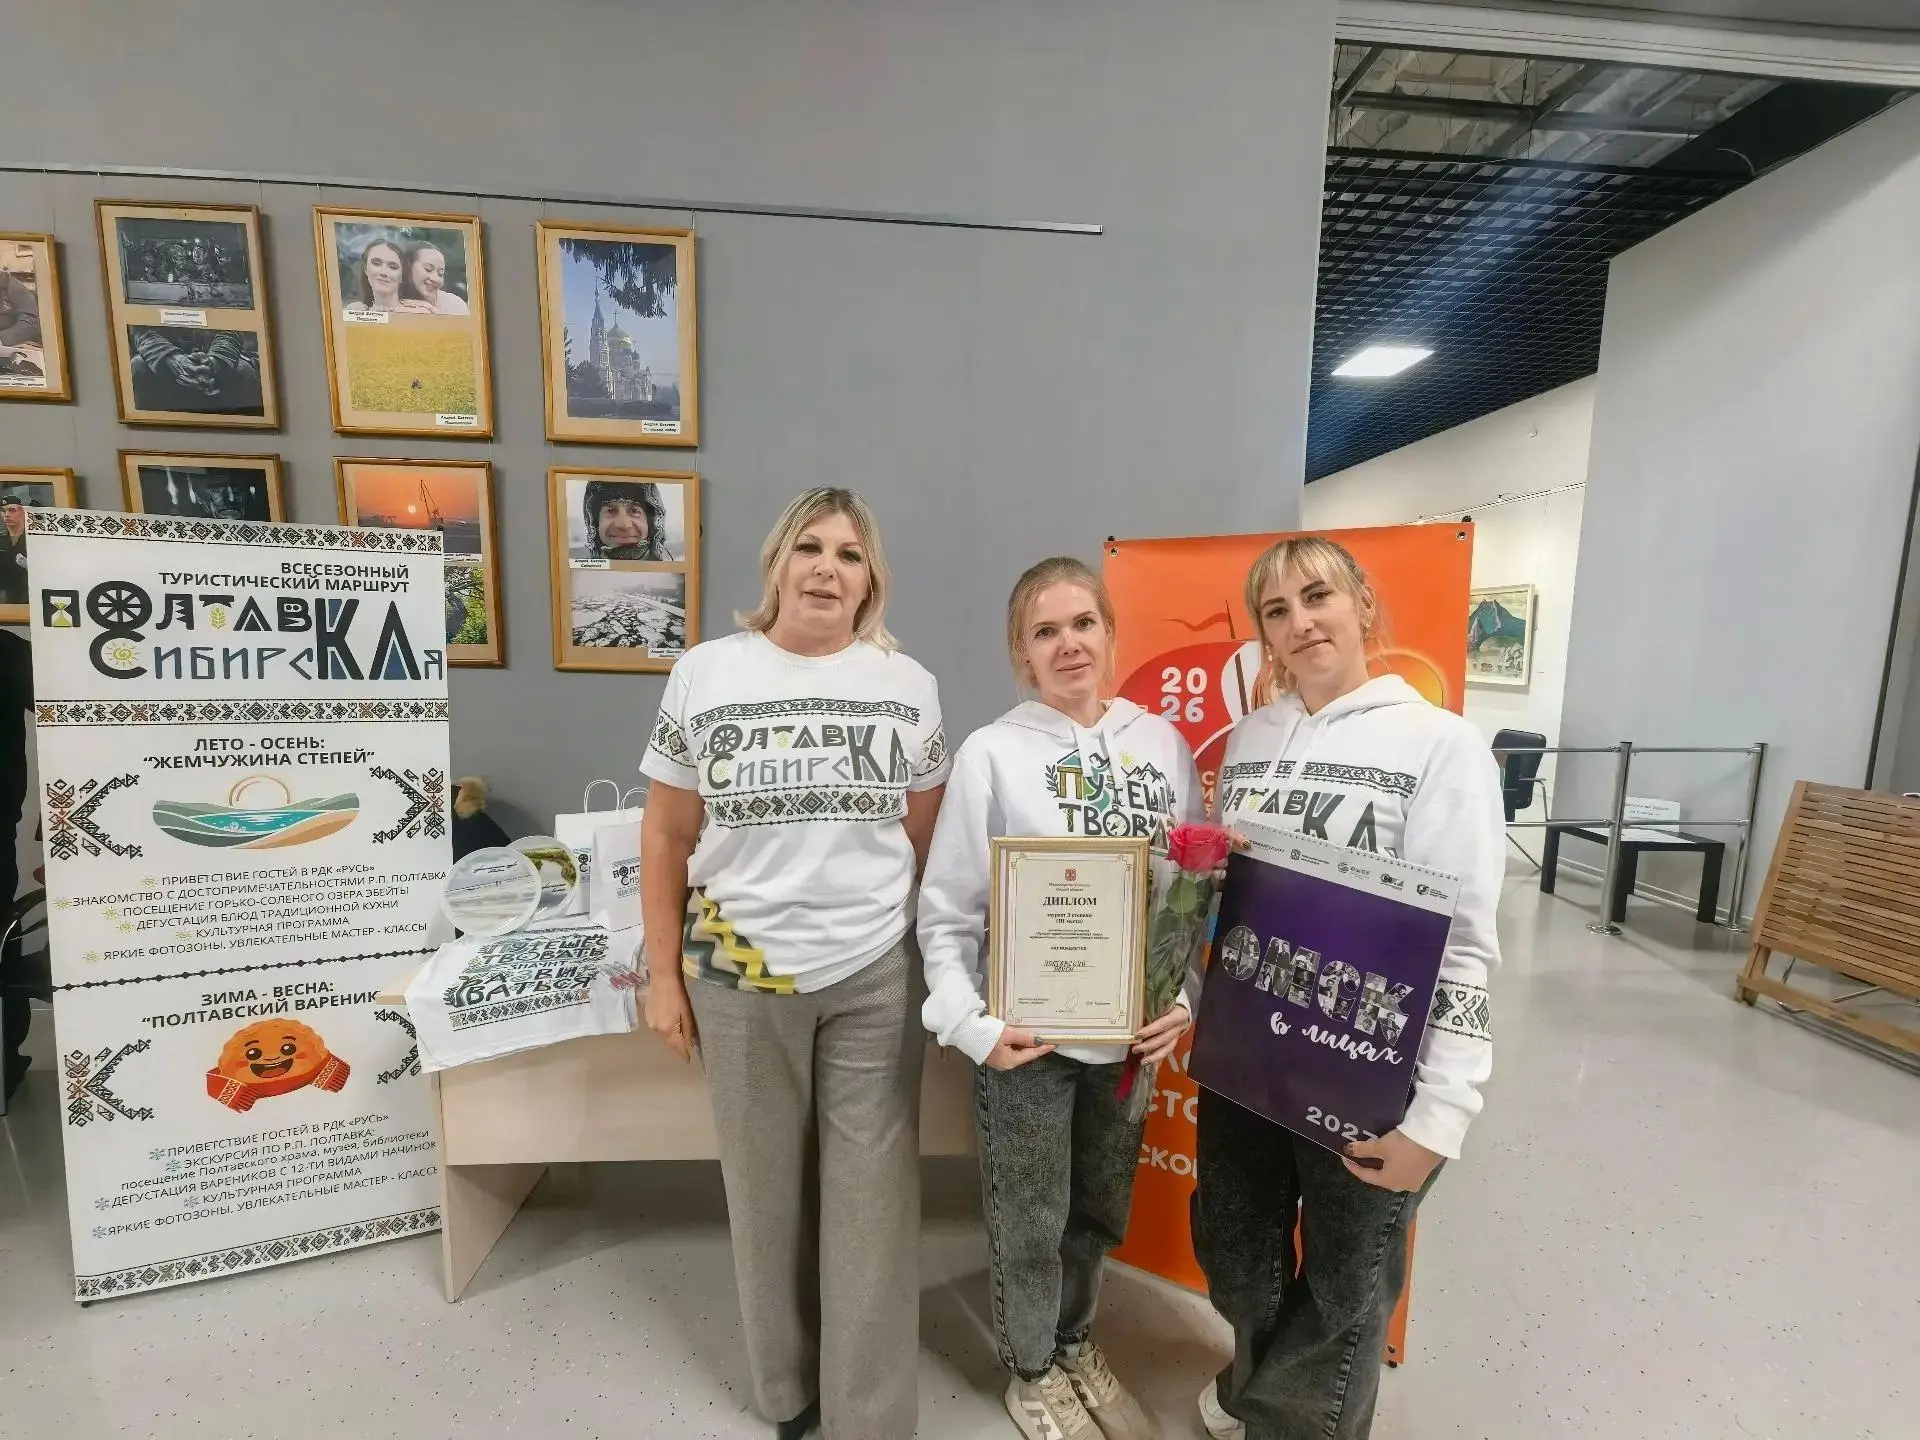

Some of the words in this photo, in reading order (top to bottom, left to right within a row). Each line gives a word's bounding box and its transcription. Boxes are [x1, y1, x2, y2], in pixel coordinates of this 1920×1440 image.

[158, 572, 320, 590] ТУРИСТИЧЕСКИЙ
[325, 579, 410, 593] МАРШРУТ
[281, 562, 410, 579] ВСЕСЕЗОННЫЙ
[1161, 666, 1207, 694] 20
[1161, 695, 1204, 723] 26
[193, 738, 244, 752] ЛЕТО
[260, 736, 326, 750] ОСЕНЬ:
[72, 891, 163, 907] ЗНАКОМСТВО
[166, 890, 176, 899] С
[177, 876, 365, 901] ДОСТОПРИМЕЧАТЕЛЬНОСТЯМИ
[368, 875, 388, 885] Р.П.
[391, 871, 447, 883] ПОЛТАВКА
[162, 871, 250, 886] ПРИВЕТСТВИЕ
[252, 866, 297, 879] ГОСТЕЙ
[301, 868, 308, 876] В
[312, 866, 333, 877] РДК
[336, 864, 375, 874] «РУСЬ»
[123, 902, 205, 917] ПОСЕЩЕНИЕ
[208, 892, 325, 910] ГОРЬКО-СОЛЕНОГО
[327, 890, 363, 900] ОЗЕРА
[366, 885, 409, 897] ЭБЕЙТЫ
[136, 914, 218, 931] ДЕГУСТАЦИЯ
[221, 910, 258, 923] БЛЮД
[262, 902, 360, 919] ТРАДИЦИОННОЙ
[362, 899, 399, 910] КУХНИ
[1043, 896, 1097, 907] ДИПЛОМ
[103, 948, 146, 961] ЯРКИЕ
[229, 931, 328, 949] УВЛЕКАТЕЛЬНЫЕ
[331, 927, 375, 939] МАСТЕР
[384, 922, 427, 934] КЛАССЫ
[196, 922, 273, 938] КУЛЬТУРНАЯ
[277, 916, 350, 929] ПРОГРАММА
[201, 989, 257, 1007] ЗИМА
[273, 981, 334, 998] ВЕСНА:
[1221, 924, 1415, 1046] ОМСК
[168, 1133, 258, 1157] ПРИВЕТСТВИЕ
[262, 1124, 309, 1142] ГОСТЕЙ
[312, 1124, 319, 1132] В
[323, 1119, 346, 1132] РДК
[348, 1113, 389, 1127] «РУСЬ»
[184, 1147, 258, 1169] ЭКСКУРСИЯ
[262, 1145, 280, 1156] ПО
[284, 1140, 306, 1152] Р.П.
[310, 1128, 376, 1147] ПОЛТАВКА:
[111, 1183, 196, 1209] ДЕГУСТАЦИЯ
[200, 1168, 276, 1191] ВАРЕНИКОВ
[279, 1166, 287, 1176] С
[291, 1161, 324, 1174] 12-ТИ
[328, 1150, 379, 1168] ВИДАМИ
[382, 1141, 436, 1157] НАЧИНОК
[121, 1170, 196, 1191] посещение
[199, 1156, 278, 1177] Полтавского
[281, 1149, 320, 1164] храма,
[363, 1130, 429, 1148] библиотеки
[203, 1181, 283, 1204] КУЛЬТУРНАЯ
[287, 1167, 362, 1189] ПРОГРАММА
[108, 1219, 150, 1236] ЯРКИЕ
[237, 1183, 339, 1211] УВЛЕКАТЕЛЬНЫЕ
[343, 1175, 388, 1191] МАСТЕР
